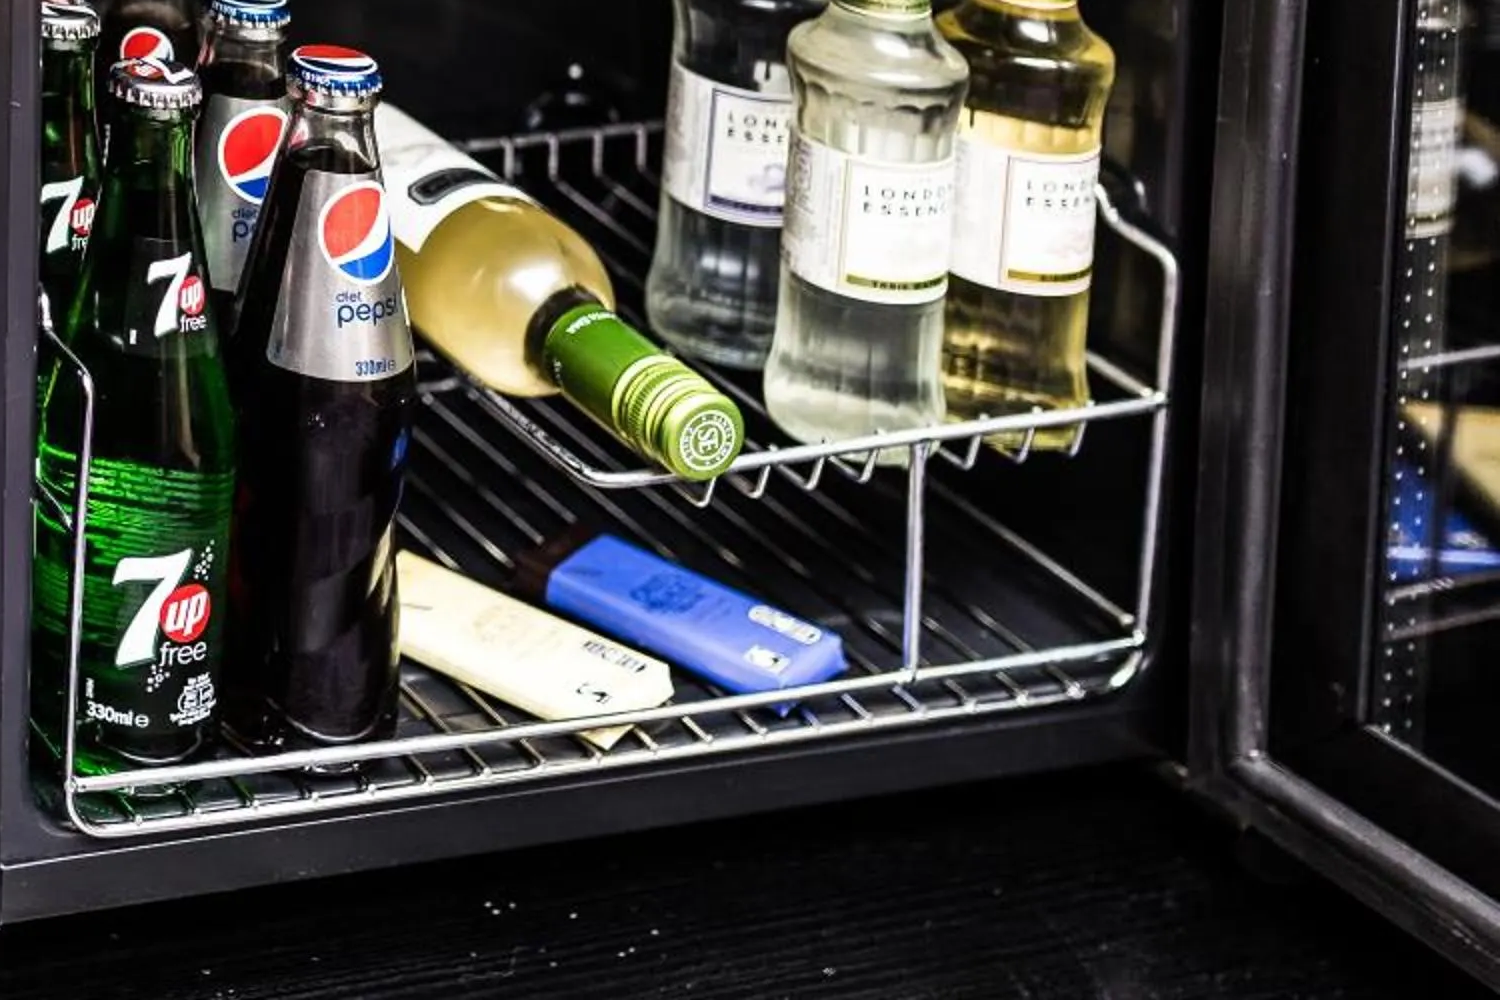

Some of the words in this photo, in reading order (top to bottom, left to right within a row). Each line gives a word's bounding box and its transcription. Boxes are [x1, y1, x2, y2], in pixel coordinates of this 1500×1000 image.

[862, 201, 947, 217] ESSEN
[335, 291, 361, 303] diet
[337, 293, 398, 329] pepsi
[180, 314, 207, 333] free
[157, 641, 208, 667] free
[86, 700, 134, 727] 330ml
